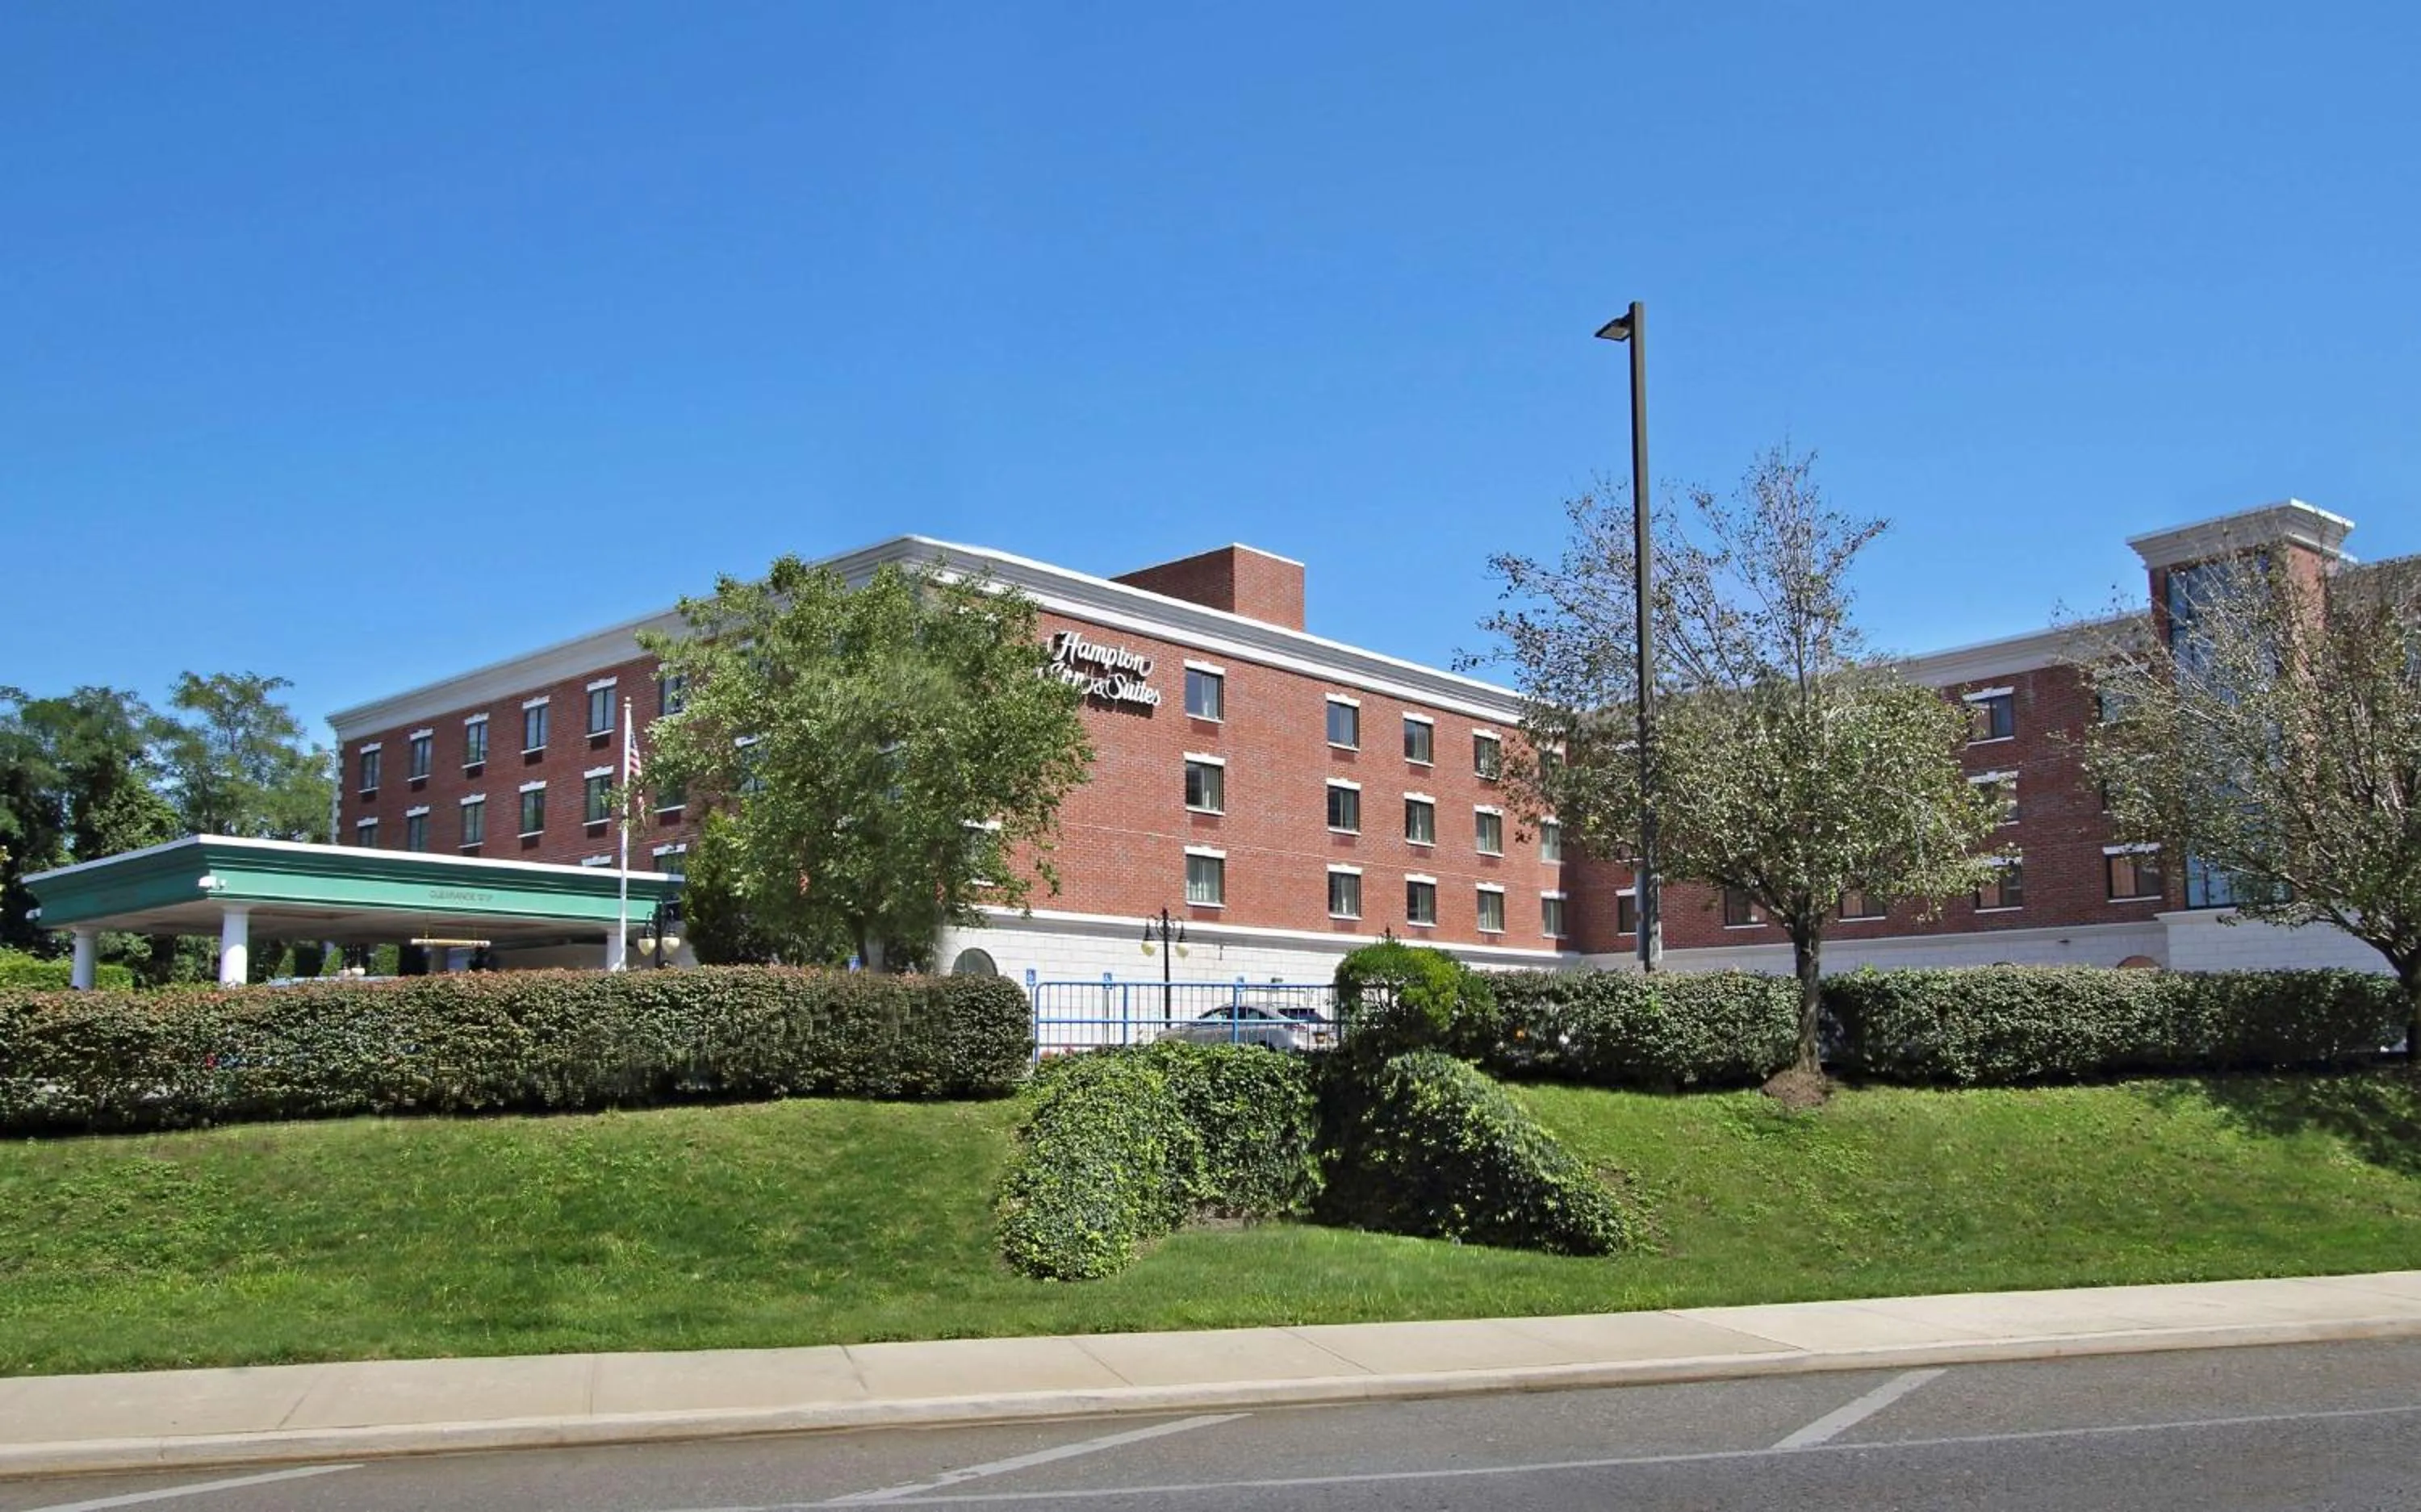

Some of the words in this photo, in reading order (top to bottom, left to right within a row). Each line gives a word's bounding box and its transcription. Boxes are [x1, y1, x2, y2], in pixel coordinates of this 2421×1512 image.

[1047, 631, 1154, 676] Hampton
[1093, 680, 1108, 700] &
[1106, 673, 1161, 706] Suites
